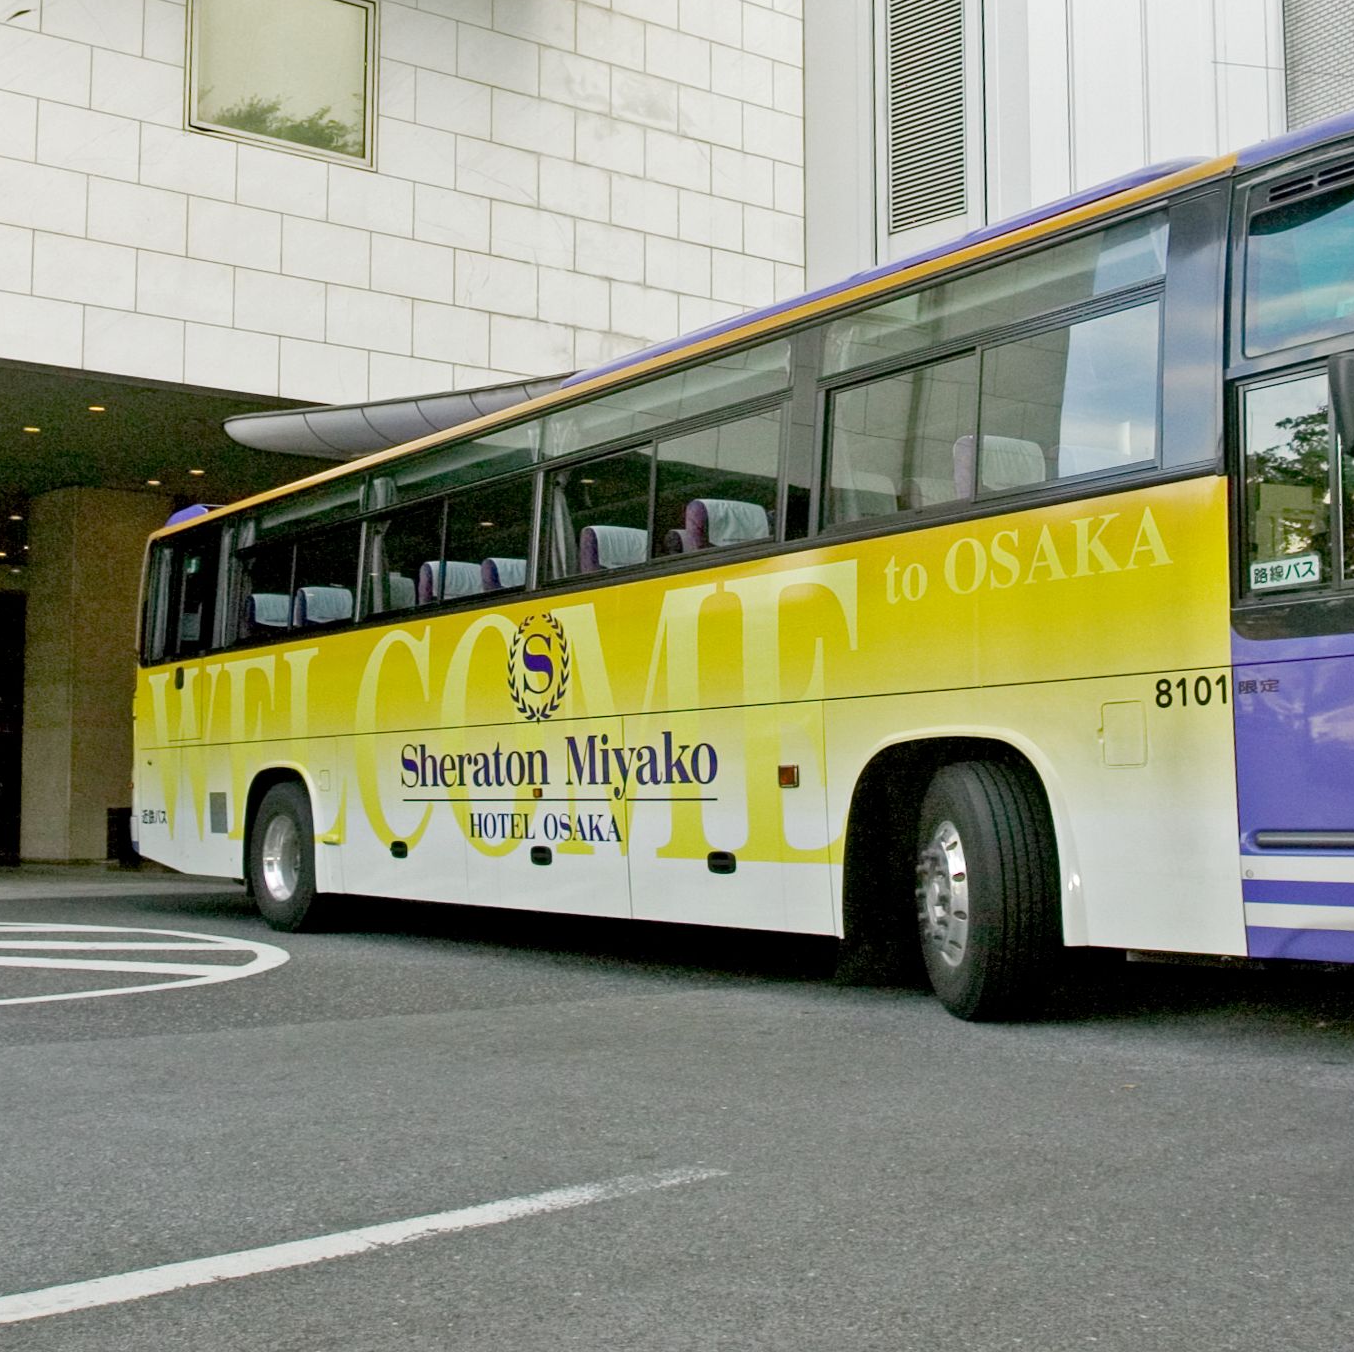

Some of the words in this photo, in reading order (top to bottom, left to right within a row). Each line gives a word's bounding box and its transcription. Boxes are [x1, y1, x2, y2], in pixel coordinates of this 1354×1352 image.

[1253, 561, 1317, 585] 路線バス
[148, 558, 858, 864] WELCOME
[883, 555, 928, 605] to
[943, 506, 1174, 596] OSAKA
[1154, 674, 1227, 709] 8101
[1237, 678, 1281, 696] 限定
[401, 742, 550, 788] Sheraton
[565, 731, 718, 800] Miyako
[469, 812, 535, 840] HOTEL
[544, 812, 624, 842] OSAKA
